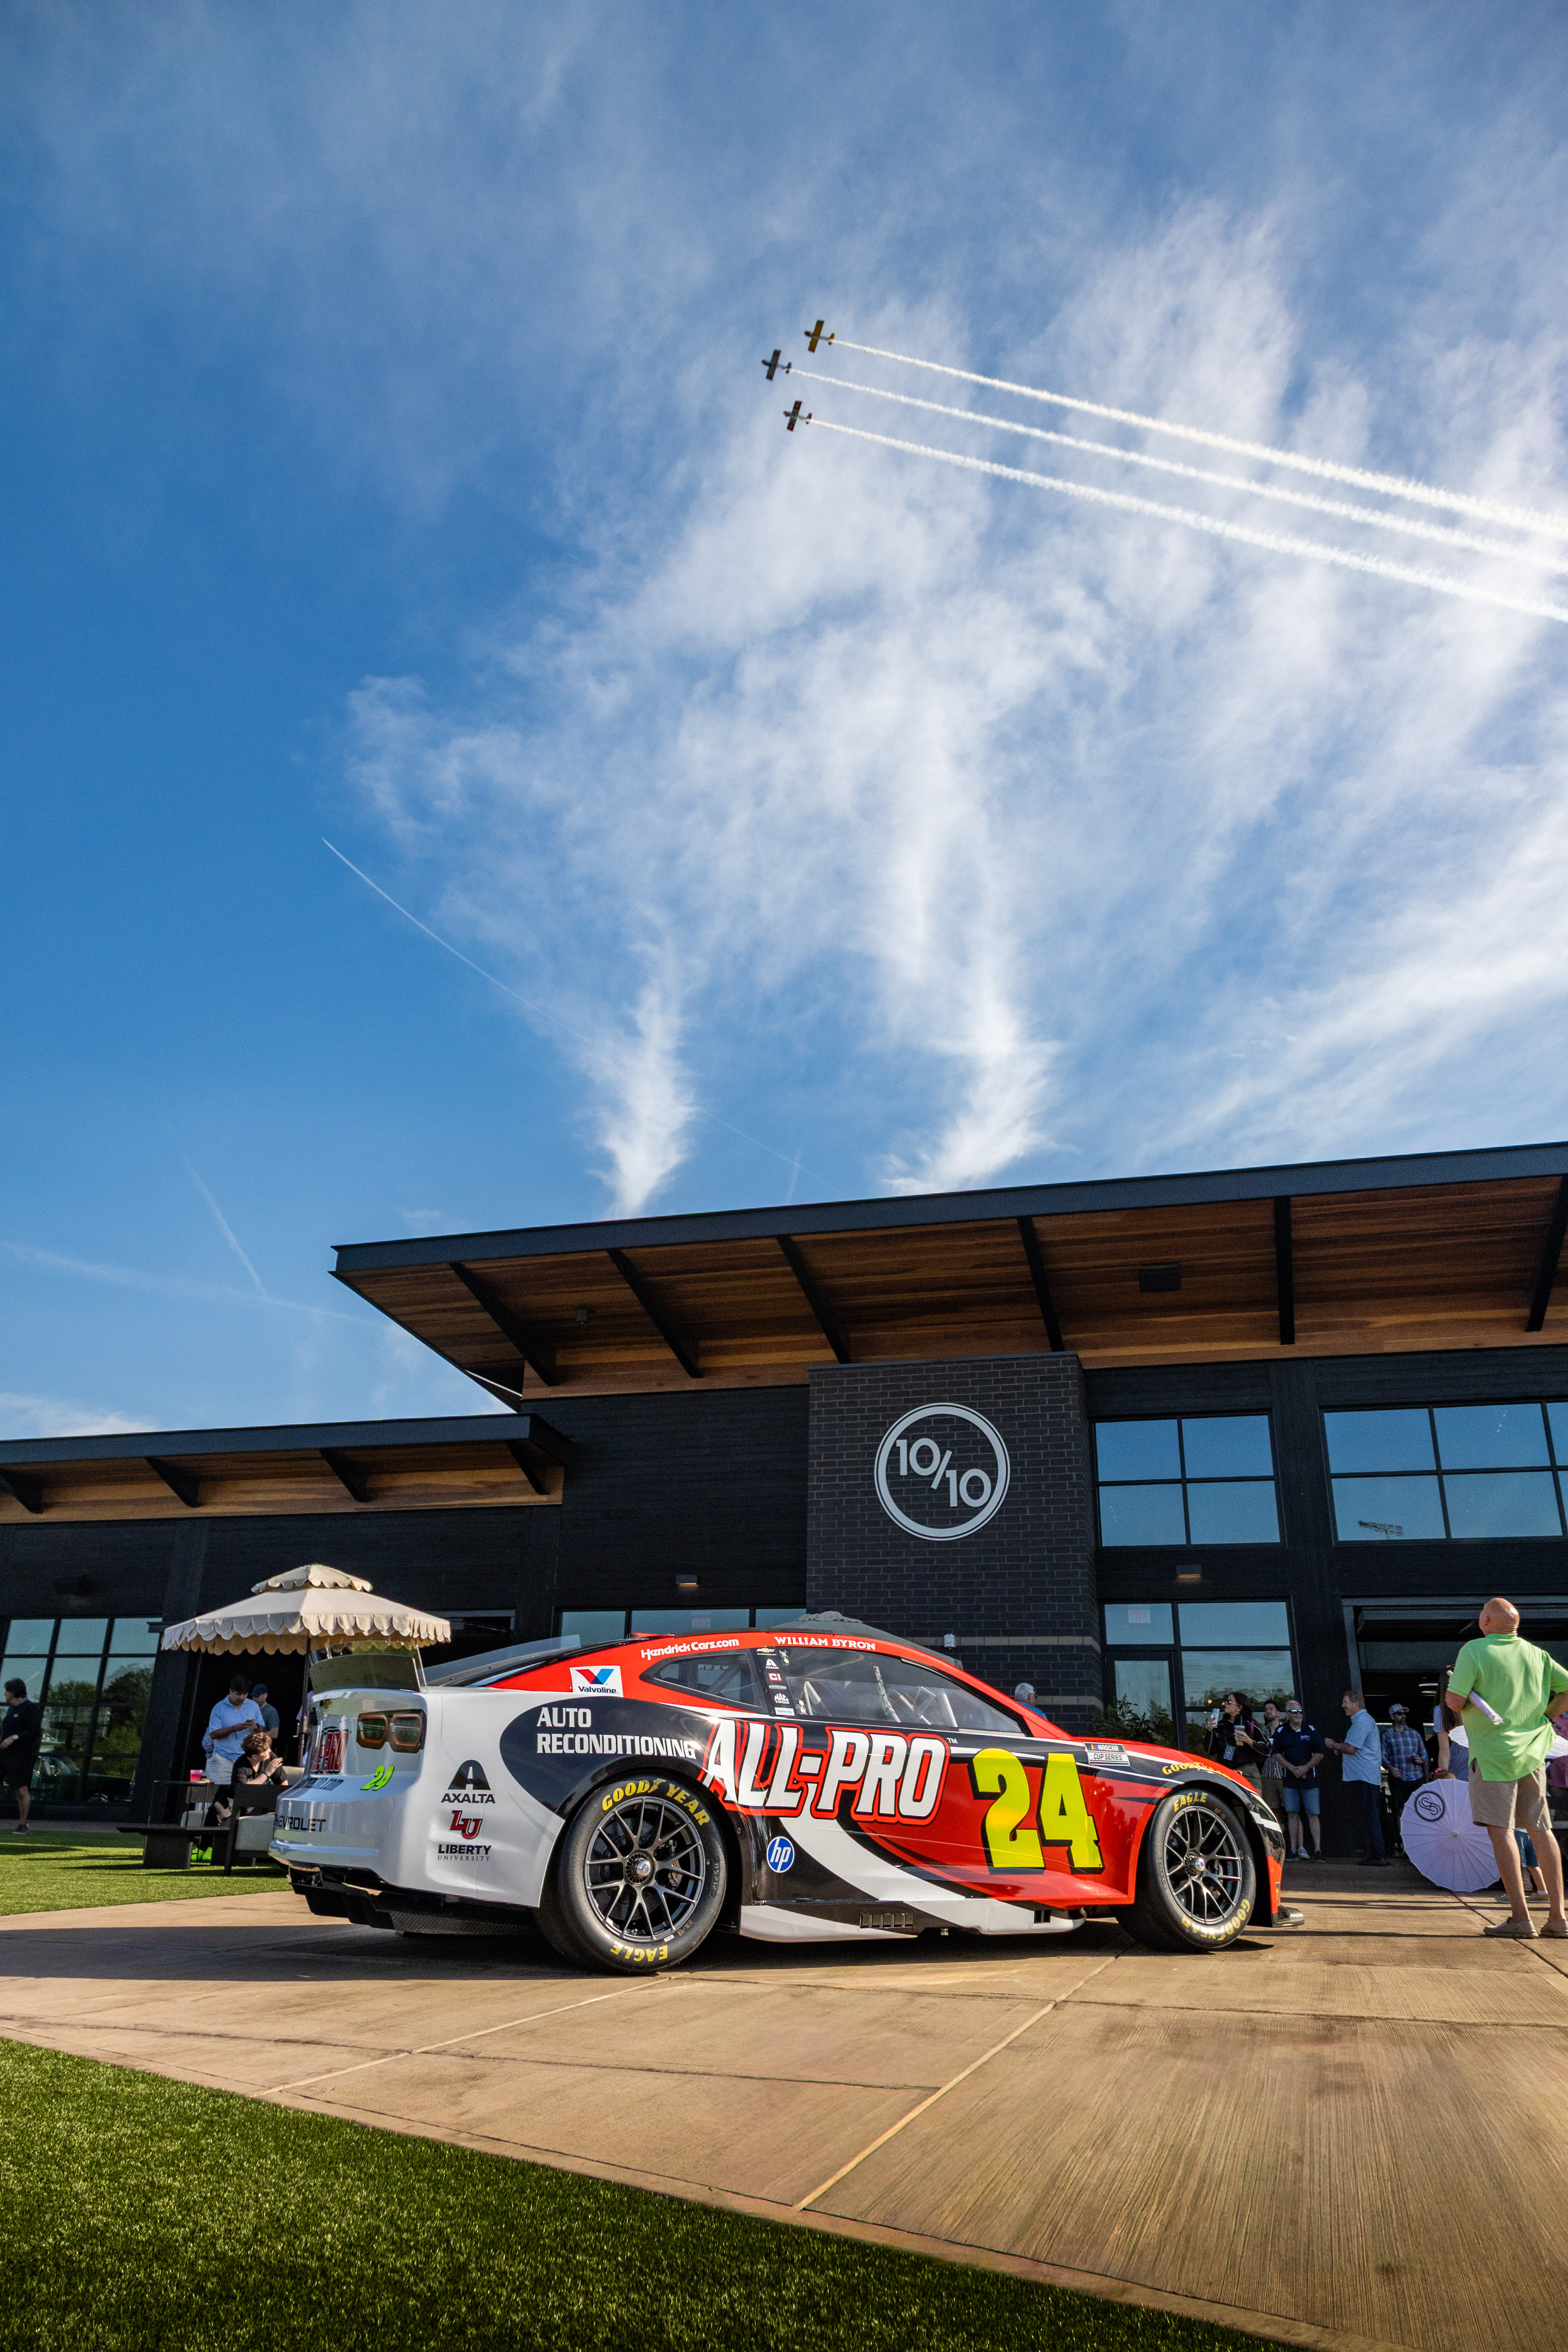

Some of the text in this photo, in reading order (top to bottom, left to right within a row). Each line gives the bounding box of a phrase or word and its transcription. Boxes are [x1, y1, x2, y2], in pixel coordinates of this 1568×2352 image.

[896, 1437, 991, 1507] 10/10
[774, 1636, 876, 1650] WILLIAM BYRON
[774, 1693, 789, 1701] MAC
[537, 1707, 592, 1727] AUTO
[537, 1733, 698, 1759] RECONDITIONING
[360, 1764, 395, 1791] 24
[701, 1719, 949, 1822] ALL-PRO
[441, 1793, 496, 1804] AXALTA
[970, 1748, 1104, 1871] 24
[1174, 1792, 1208, 1812] EAGLE
[450, 1810, 483, 1839] LU
[438, 1844, 492, 1855] LIBERTY
[769, 1837, 791, 1872] hp
[610, 1940, 668, 1962] EAGLE
